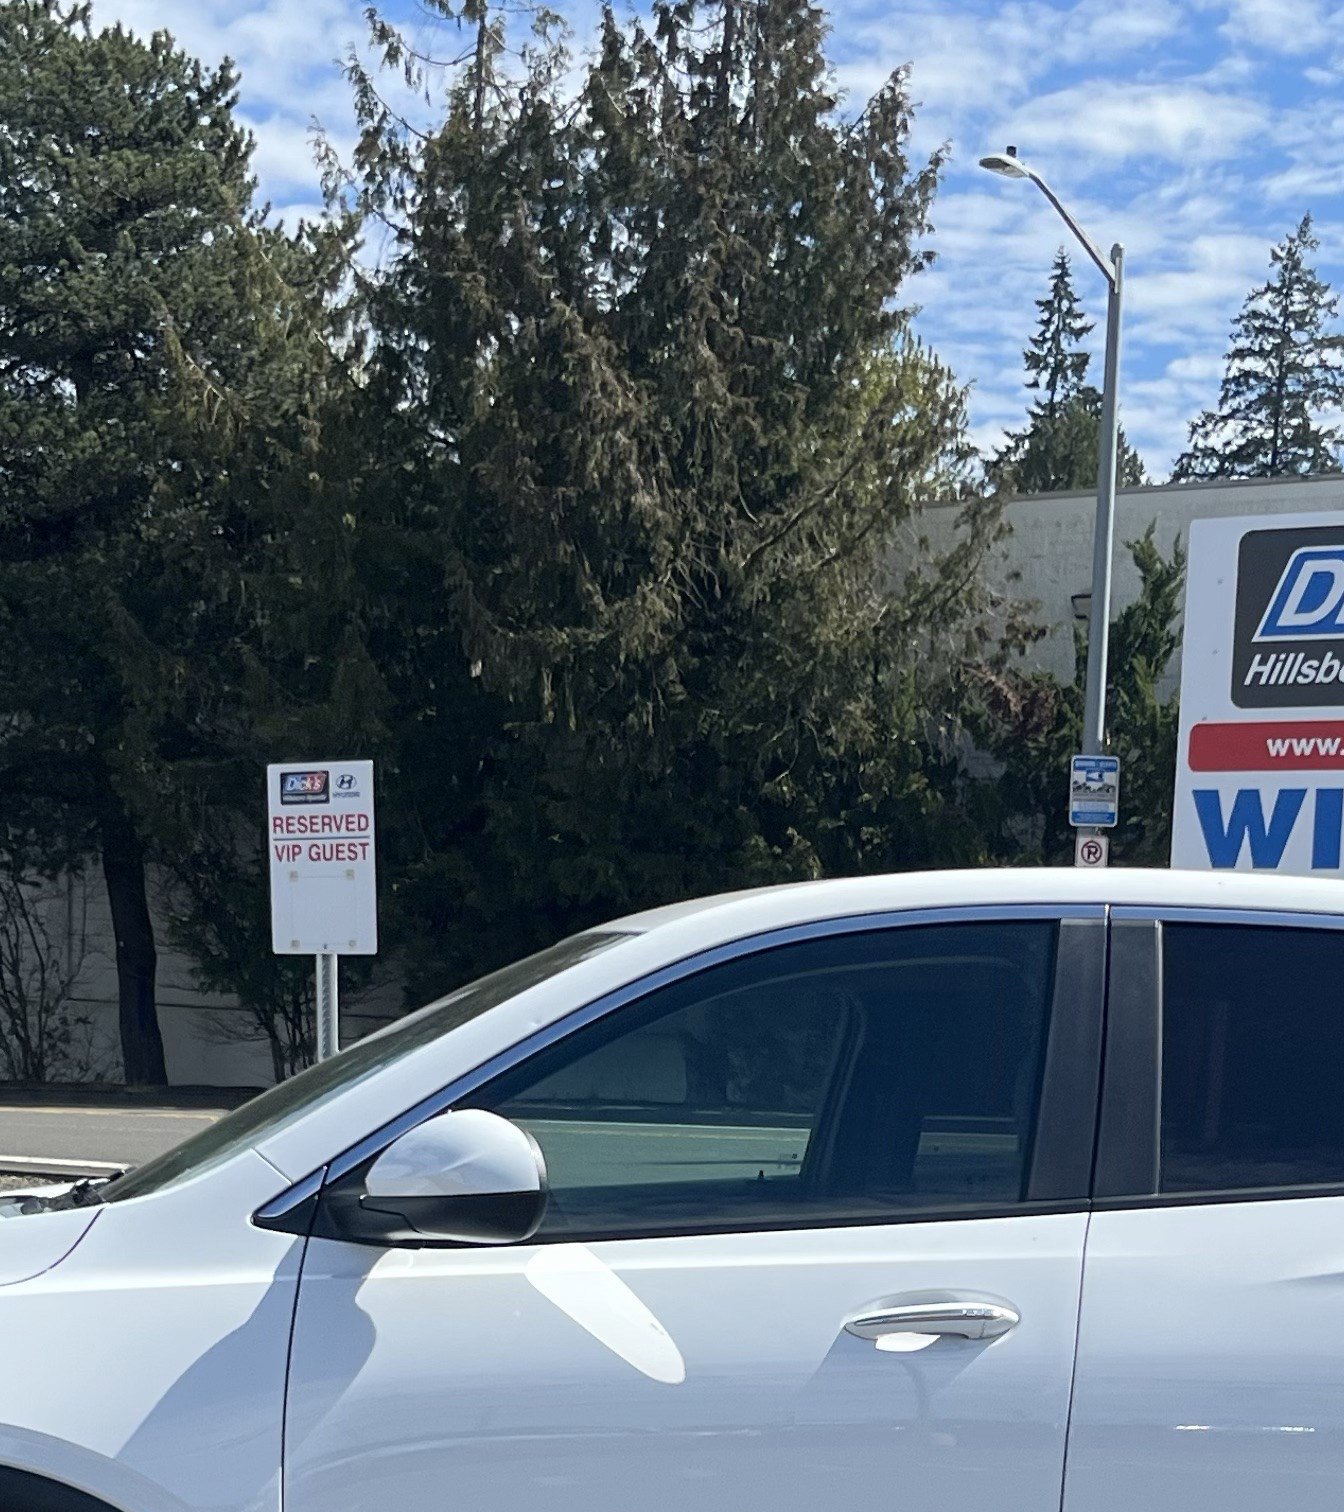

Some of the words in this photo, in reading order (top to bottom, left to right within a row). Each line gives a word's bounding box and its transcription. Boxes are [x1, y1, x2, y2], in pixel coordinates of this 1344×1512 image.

[272, 813, 370, 835] RESERVED
[274, 844, 302, 863] VIP
[308, 842, 370, 862] GUEST
